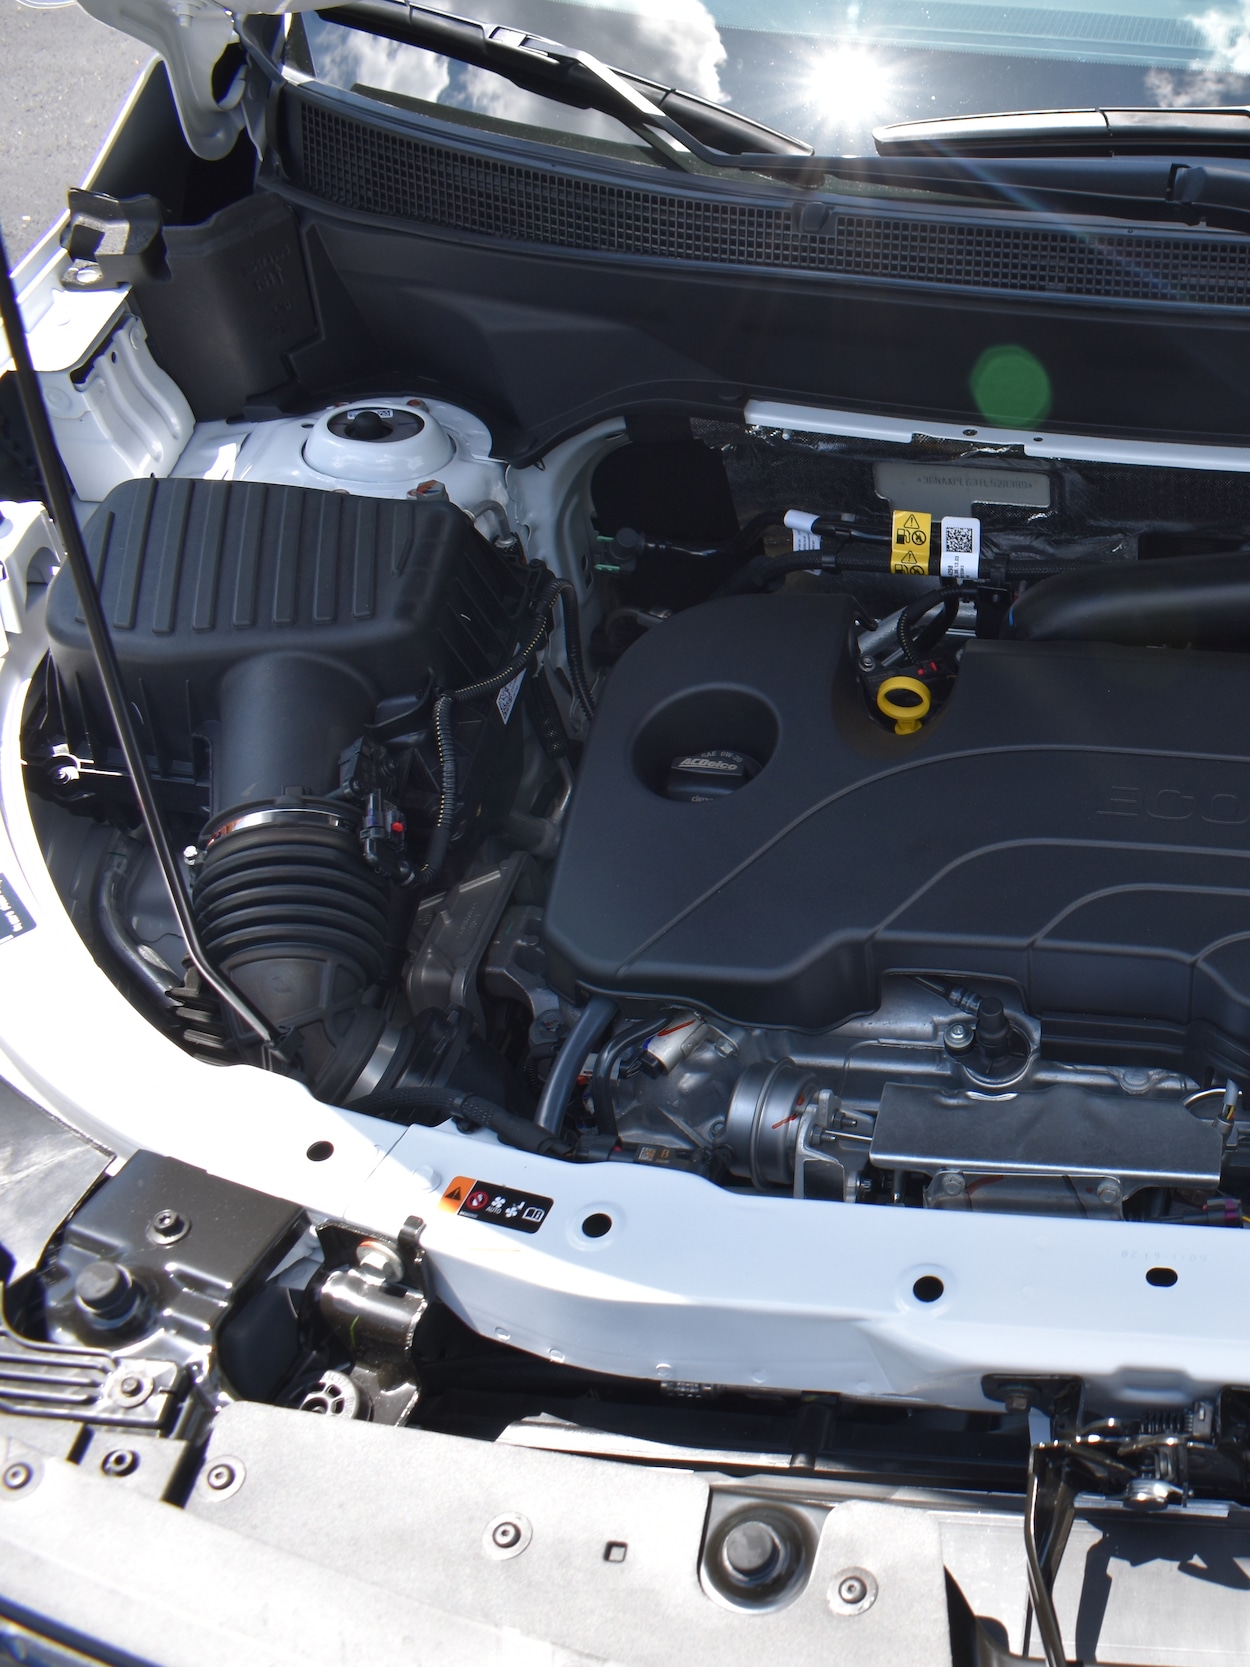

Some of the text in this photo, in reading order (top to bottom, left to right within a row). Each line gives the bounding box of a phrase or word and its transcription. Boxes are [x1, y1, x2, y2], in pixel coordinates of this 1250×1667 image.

[701, 750, 718, 758] SAE
[678, 758, 738, 771] ACDelco
[486, 1206, 502, 1215] AUTO
